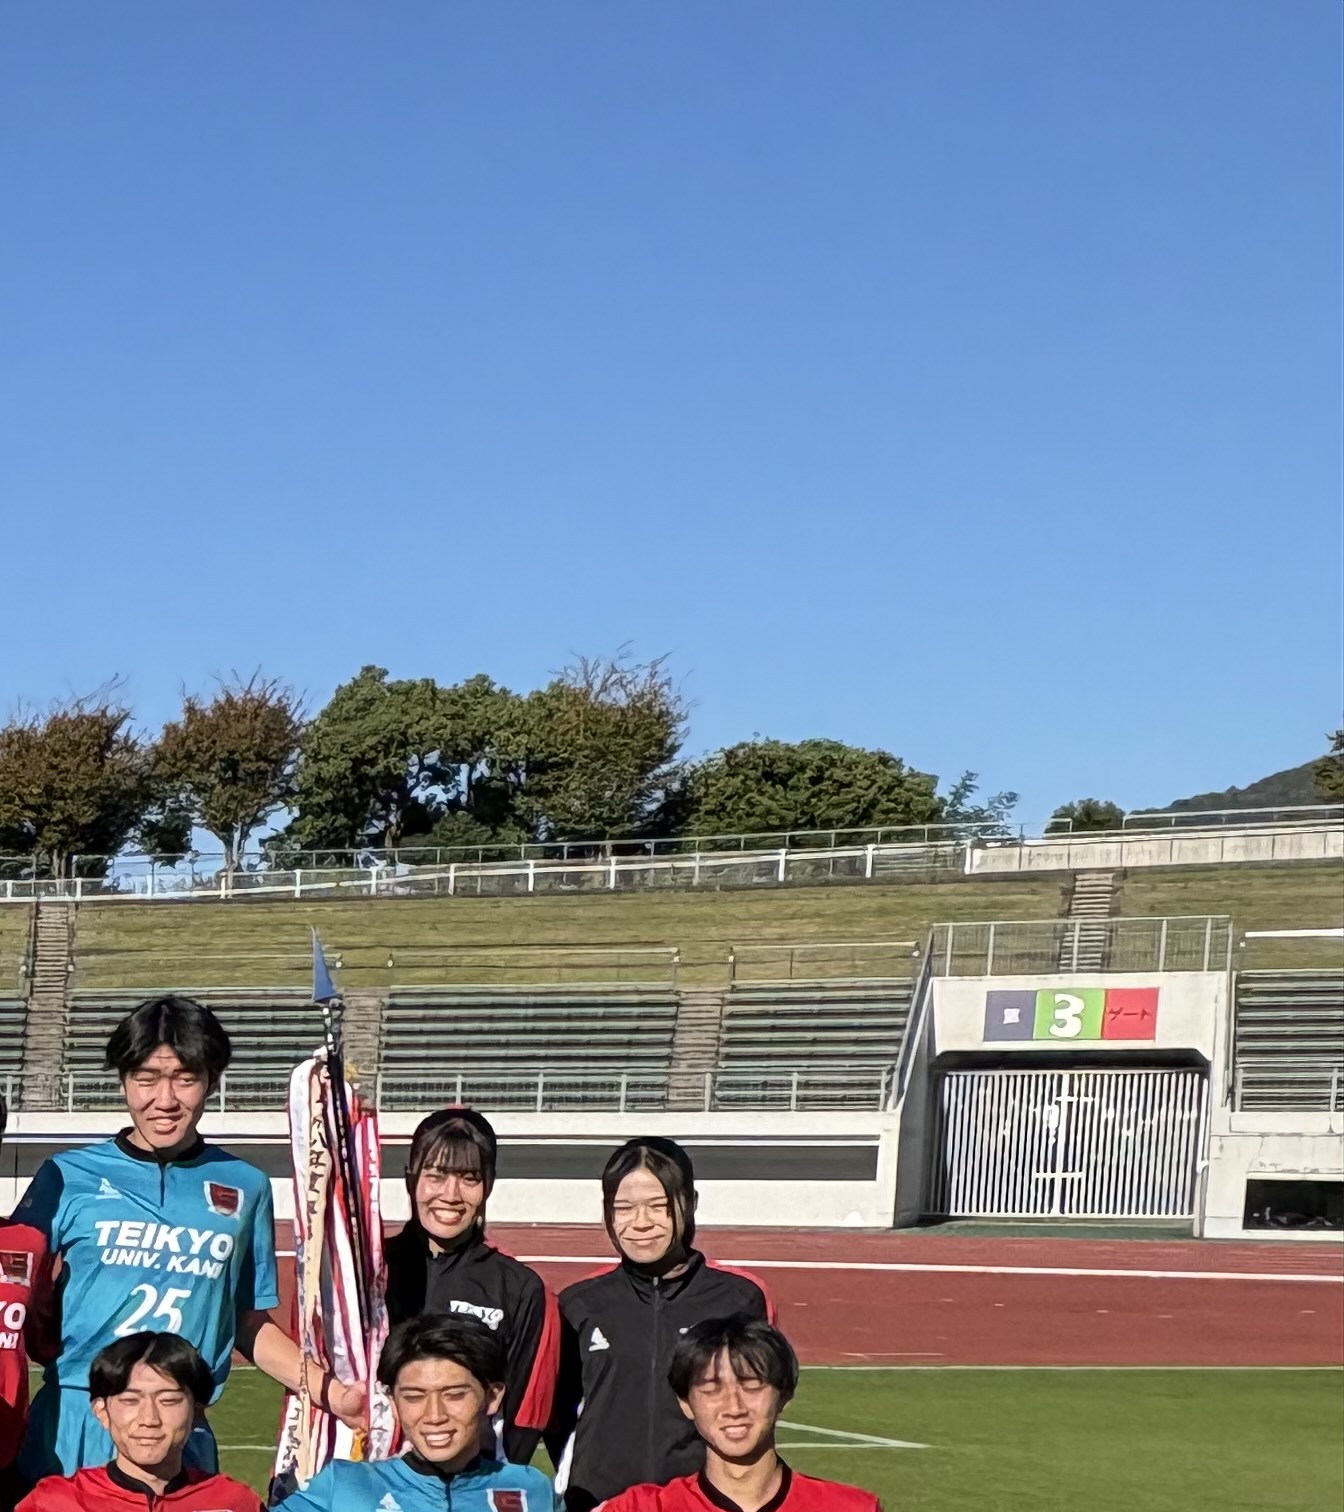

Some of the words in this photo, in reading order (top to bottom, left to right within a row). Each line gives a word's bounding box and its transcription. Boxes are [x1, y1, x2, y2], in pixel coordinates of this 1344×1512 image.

[1049, 993, 1085, 1038] 3
[95, 1221, 233, 1260] TEIKYO
[101, 1249, 161, 1269] UNIV.
[166, 1255, 223, 1278] KANI
[115, 1284, 191, 1333] 25
